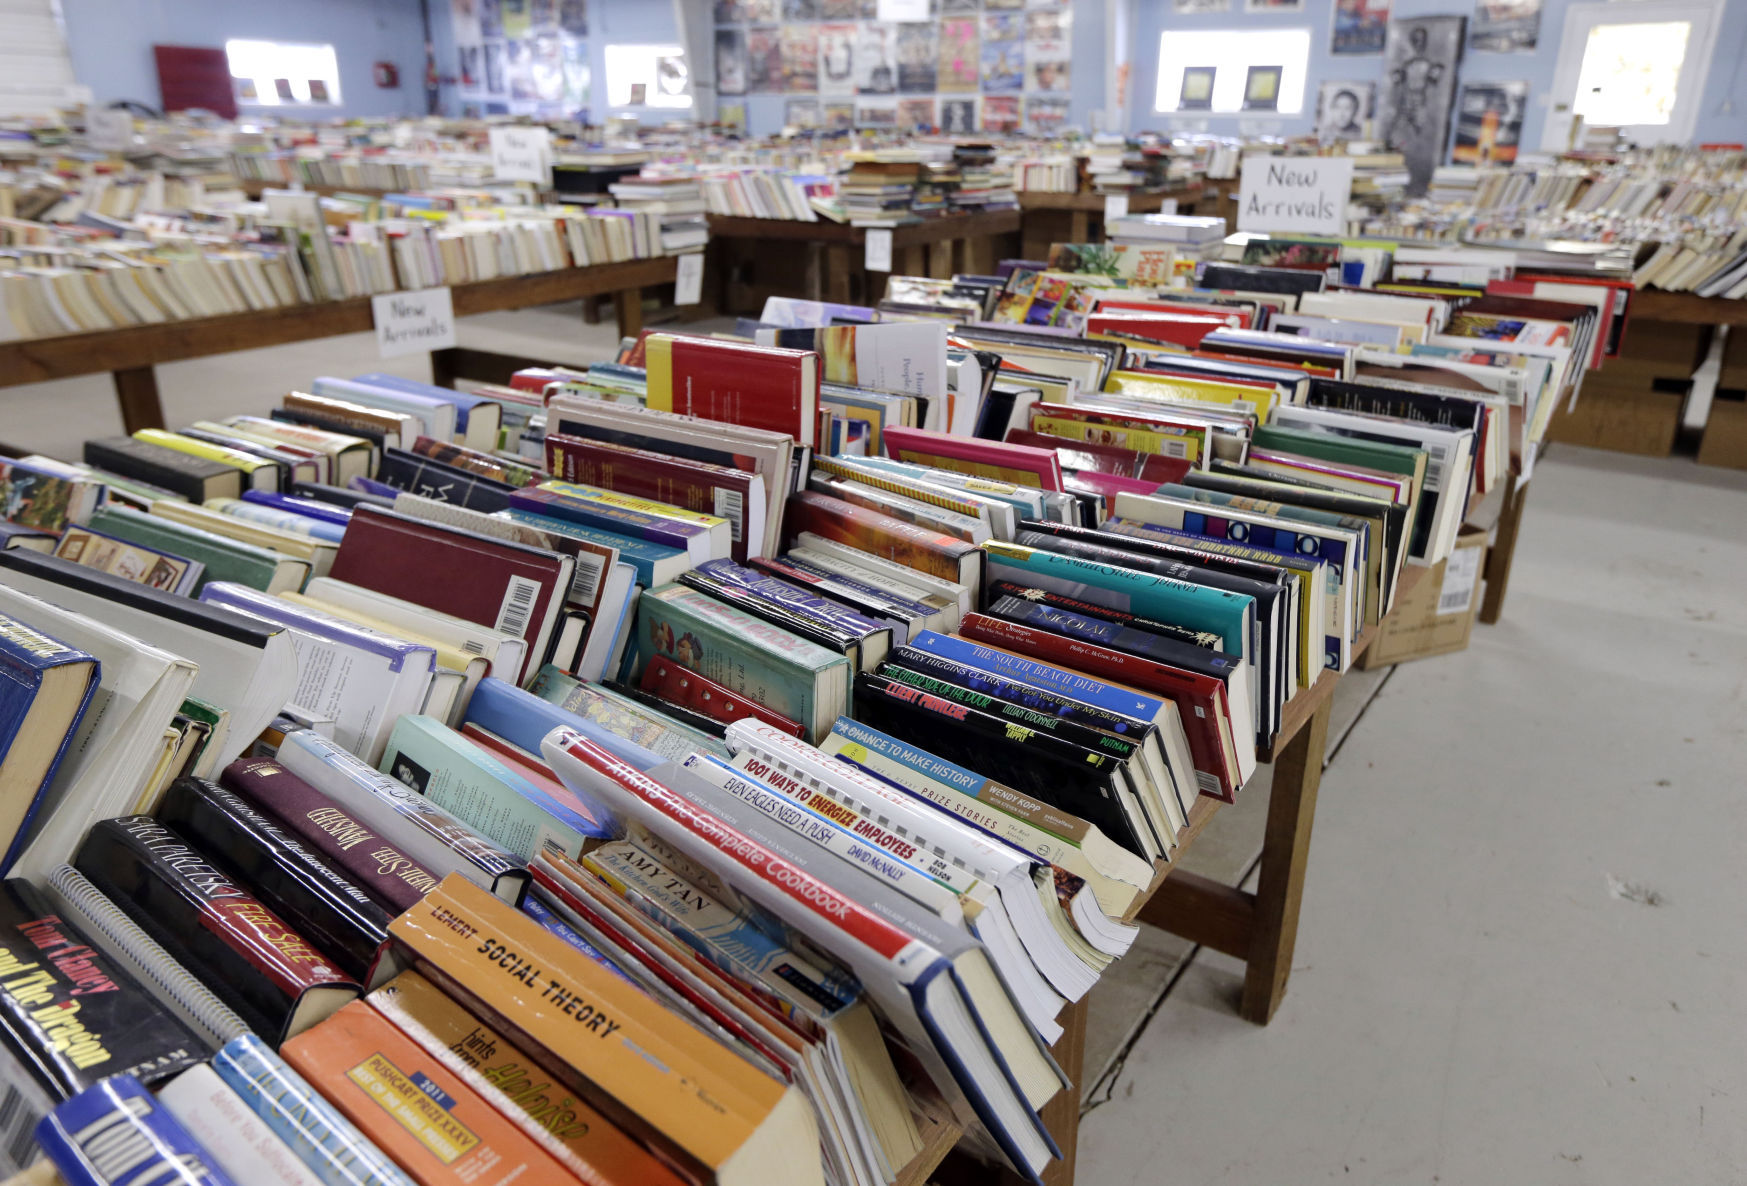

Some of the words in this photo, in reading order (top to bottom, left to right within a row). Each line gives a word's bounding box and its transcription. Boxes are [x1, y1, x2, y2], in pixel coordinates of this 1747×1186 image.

[1267, 163, 1318, 187] New
[1246, 192, 1335, 220] Arrivals
[390, 300, 427, 320] New
[382, 317, 449, 344] Arrivals
[1193, 540, 1251, 558] JONATHAN
[1149, 575, 1199, 593] JOURNEY
[978, 616, 1003, 629] LIFE
[1038, 610, 1112, 638] NICOLAE
[1045, 593, 1134, 621] ENTERTAINMENTS
[897, 648, 925, 665] MARY
[926, 657, 968, 678] HIGGINS
[968, 669, 1003, 687] CLARK
[1005, 681, 1021, 694] I've
[1020, 686, 1038, 699] Got
[1038, 691, 1057, 705] You
[1055, 697, 1086, 713] Under
[1084, 704, 1101, 719] My
[1099, 708, 1121, 723] Skin
[972, 646, 996, 661] THE
[993, 653, 1032, 672] SOUTH
[1033, 662, 1072, 685] BEACH
[1073, 676, 1106, 695] DIET
[993, 663, 1021, 680] Arthur
[884, 664, 899, 680] THE
[898, 671, 925, 689] OTHER
[923, 677, 941, 695] SIDE
[949, 686, 967, 702] THE
[965, 692, 992, 709] DOOR
[1002, 704, 1026, 720] LILLIAN
[1099, 736, 1130, 753] PUTNAM
[885, 681, 919, 704] CLIENT
[917, 693, 970, 721] PRIVILEGE
[1004, 731, 1027, 744] TAPPLY
[849, 727, 888, 751] CHANCE
[888, 743, 902, 757] TO
[901, 750, 931, 769] MAKE
[929, 760, 979, 789] HISTORY
[988, 785, 1019, 805] WENDY
[1016, 796, 1042, 813] KOPP
[743, 758, 770, 779] 1001
[767, 770, 798, 796] WAYS
[795, 786, 811, 802] TO
[807, 793, 858, 828] ENERGIZE
[853, 819, 917, 860] EMPLOYEES
[921, 787, 951, 808] PRIZE
[954, 803, 998, 830] STORIES
[306, 806, 376, 852] VANISHED
[723, 777, 749, 799] EVEN
[743, 786, 780, 817] EAGLES
[774, 804, 802, 828] NEED
[797, 818, 809, 833] A
[805, 823, 837, 846] PUSH
[847, 844, 873, 866] DAVID
[869, 855, 907, 882] McNALLY
[299, 849, 350, 890] Innocent
[342, 878, 371, 904] Man
[370, 845, 412, 876] STEEL
[398, 861, 438, 895] NIELLE
[664, 796, 690, 820] The
[692, 814, 765, 866] Complete
[765, 858, 851, 921] Cookbook
[927, 864, 952, 883] NELSON
[932, 858, 948, 871] BOB
[115, 816, 168, 846] SARA
[152, 843, 251, 901] PARETSKY
[226, 902, 284, 937] FIRE
[263, 932, 325, 965] SALE
[604, 854, 621, 868] The
[618, 862, 649, 888] Kitchen
[646, 882, 671, 905] God's
[666, 896, 690, 917] Wife
[618, 849, 668, 884] AMY
[664, 878, 711, 913] TAN
[16, 914, 68, 950] Tom
[47, 944, 121, 997] Clancy
[554, 923, 569, 939] You
[566, 932, 585, 951] Can't
[430, 905, 479, 941] LEMERT
[476, 937, 537, 989] SOCIAL
[541, 980, 622, 1040] THEORY
[2, 969, 58, 1008] The
[30, 997, 113, 1071] Dragon
[462, 1027, 498, 1062] hints
[368, 1057, 419, 1101] PUSHCART
[413, 1096, 444, 1127] PRIZE
[437, 1117, 474, 1148] XXXV
[418, 1078, 447, 1103] 2011
[483, 1062, 590, 1140] Heloise
